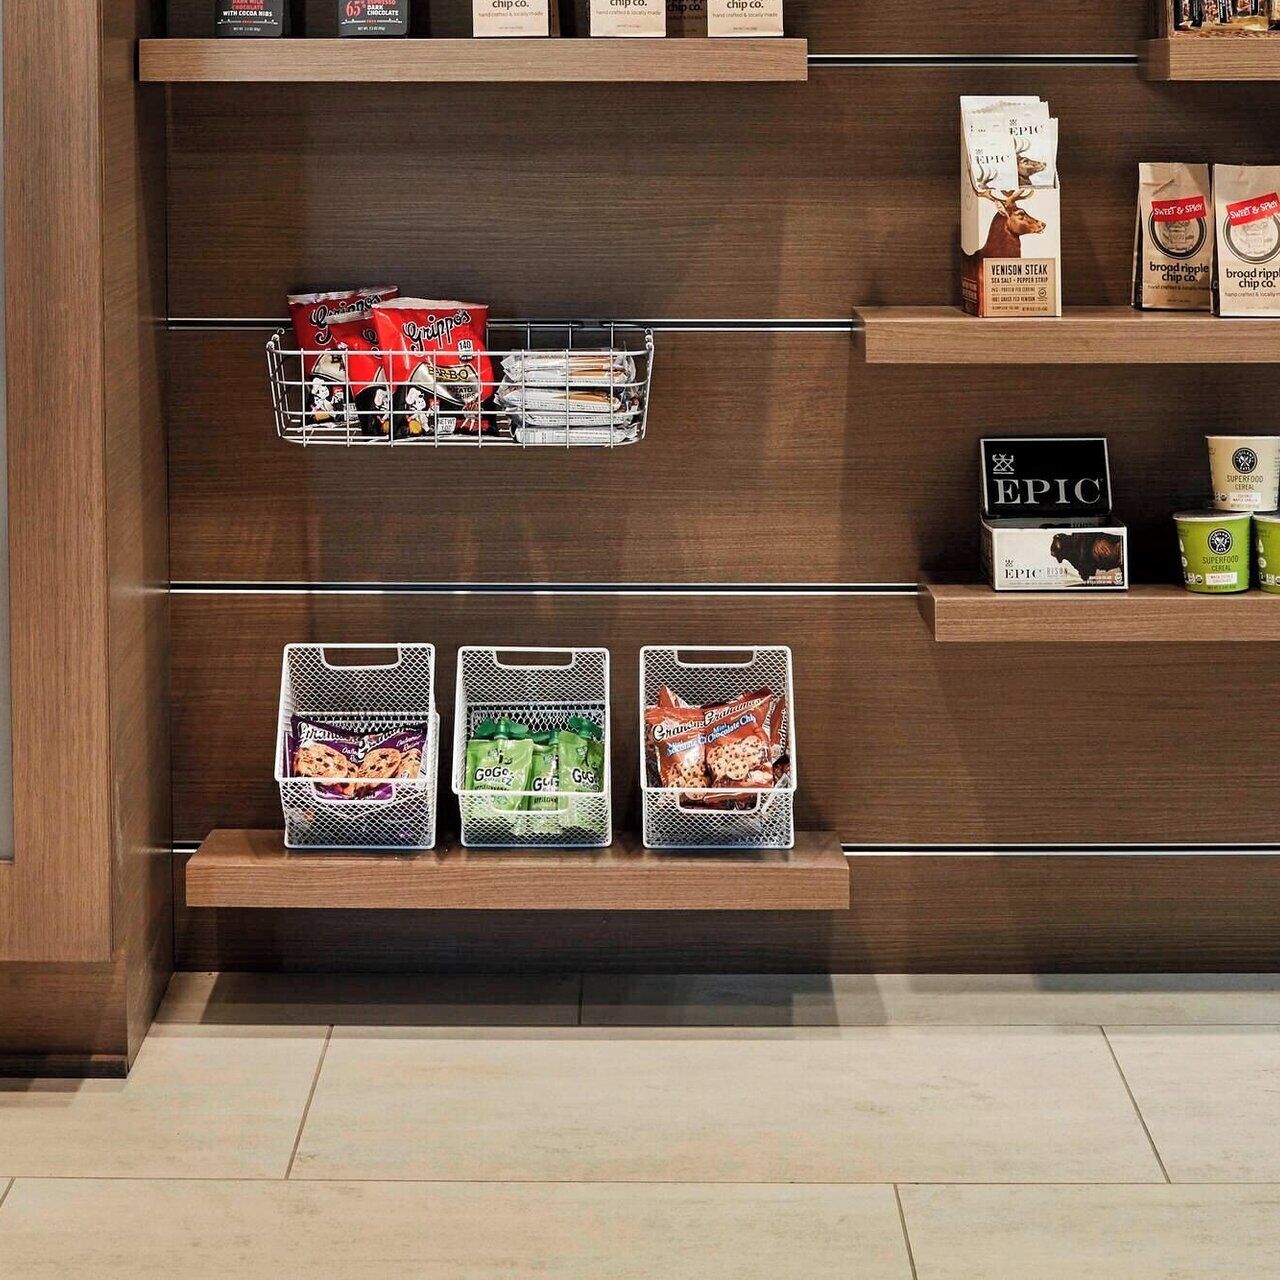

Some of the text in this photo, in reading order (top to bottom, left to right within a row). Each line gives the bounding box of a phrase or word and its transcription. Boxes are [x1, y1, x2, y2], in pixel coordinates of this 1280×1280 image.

[515, 0, 529, 8] co.
[727, 0, 763, 11] chip co.
[1010, 125, 1043, 136] EPIC
[1153, 203, 1203, 216] SWEET & SPICY
[991, 264, 1048, 276] VENISON STEAK
[1226, 269, 1256, 278] broad
[1239, 279, 1276, 289] chip co.
[993, 478, 1100, 504] EPIC
[1202, 556, 1239, 564] SUPERFOOD
